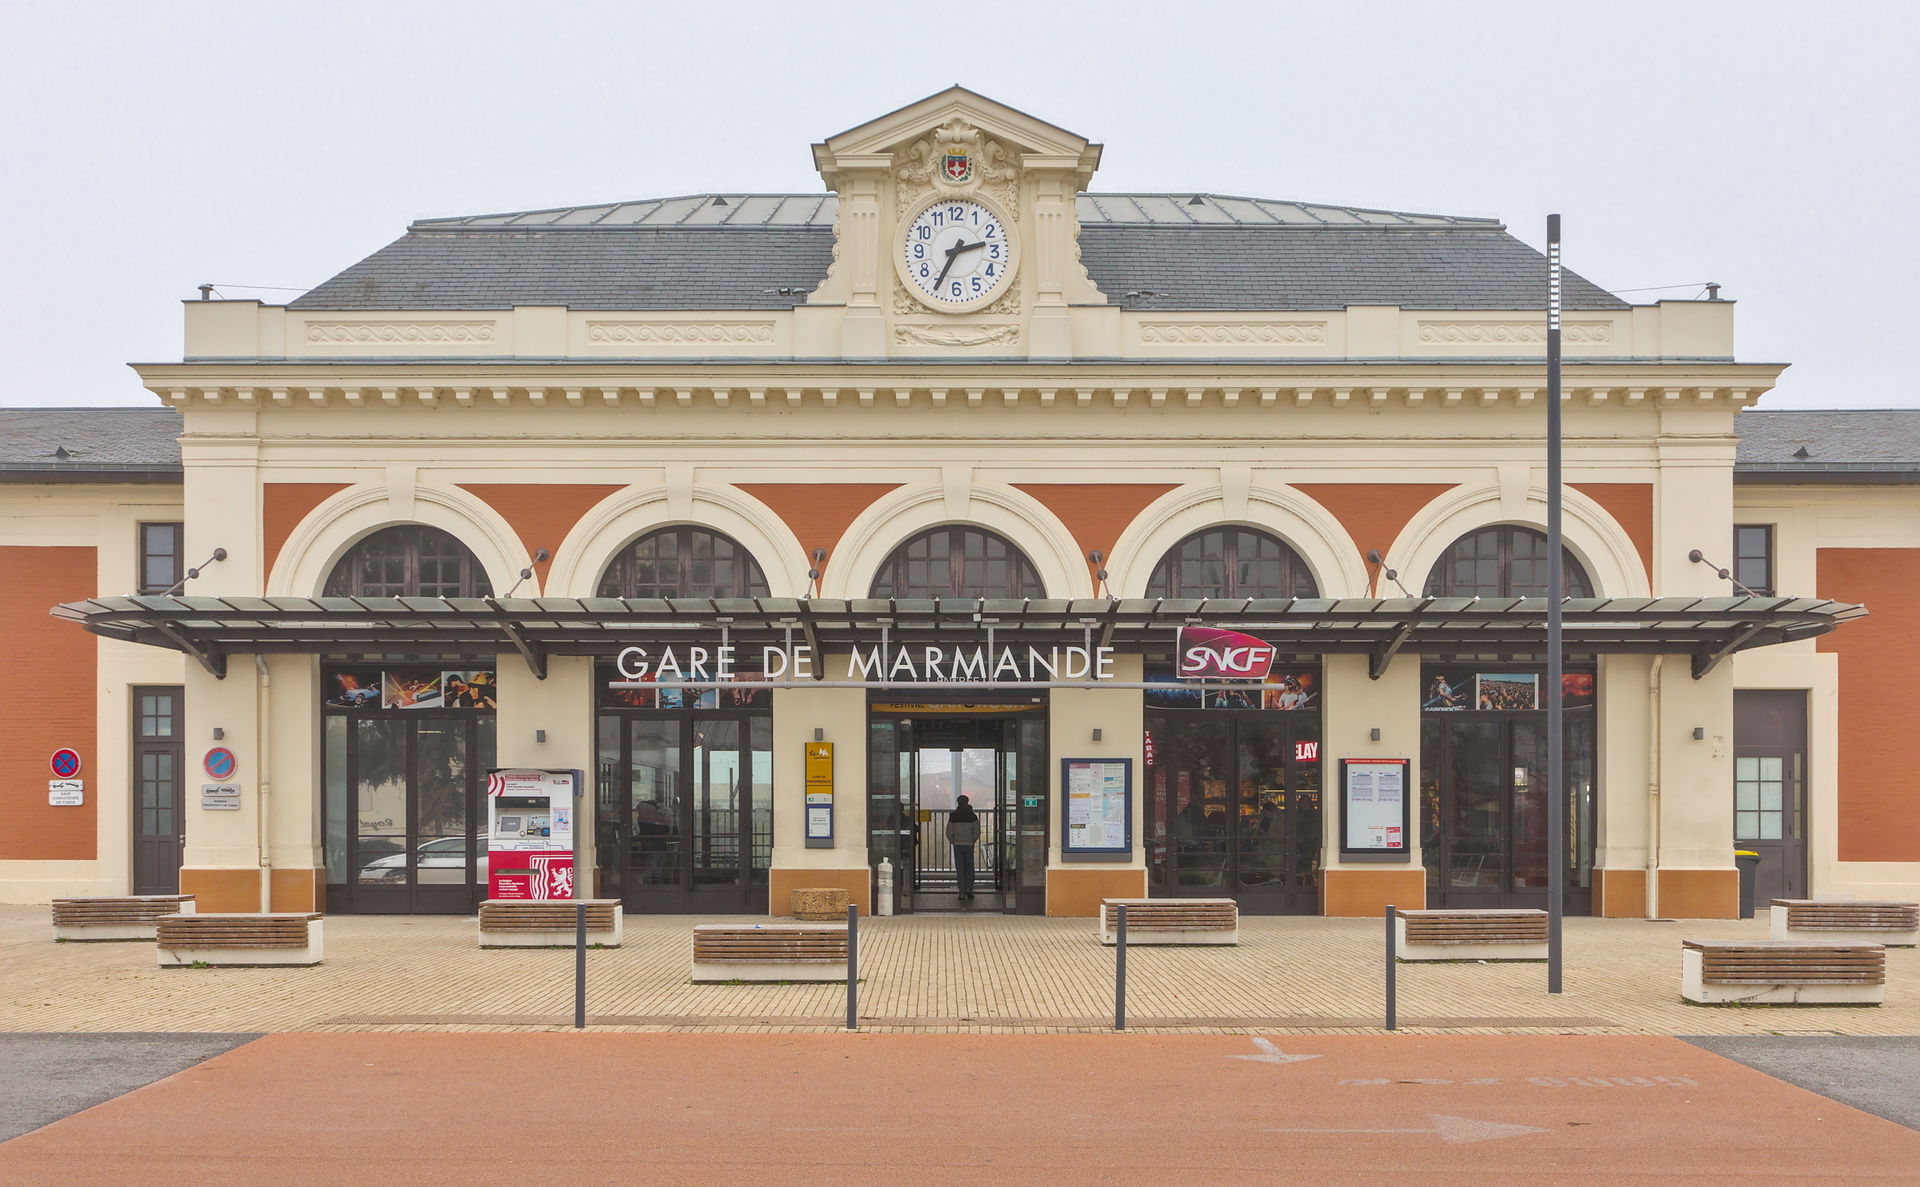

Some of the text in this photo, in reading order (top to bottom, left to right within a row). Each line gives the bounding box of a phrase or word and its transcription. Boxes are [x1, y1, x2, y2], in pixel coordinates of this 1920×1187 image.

[931, 211, 944, 226] 11
[947, 206, 964, 221] 12
[971, 211, 978, 225] 1
[916, 225, 931, 240] 10
[985, 224, 996, 239] 2
[914, 244, 924, 259] 9
[989, 244, 1000, 259] 3
[919, 262, 930, 278] 8
[985, 262, 995, 277] 4
[951, 281, 962, 297] 6
[971, 277, 981, 292] 5
[616, 644, 1115, 680] GARE DE MARMANDE
[1182, 646, 1273, 672] SNCF
[1144, 730, 1154, 766] TABAC
[1296, 742, 1319, 760] ELAY
